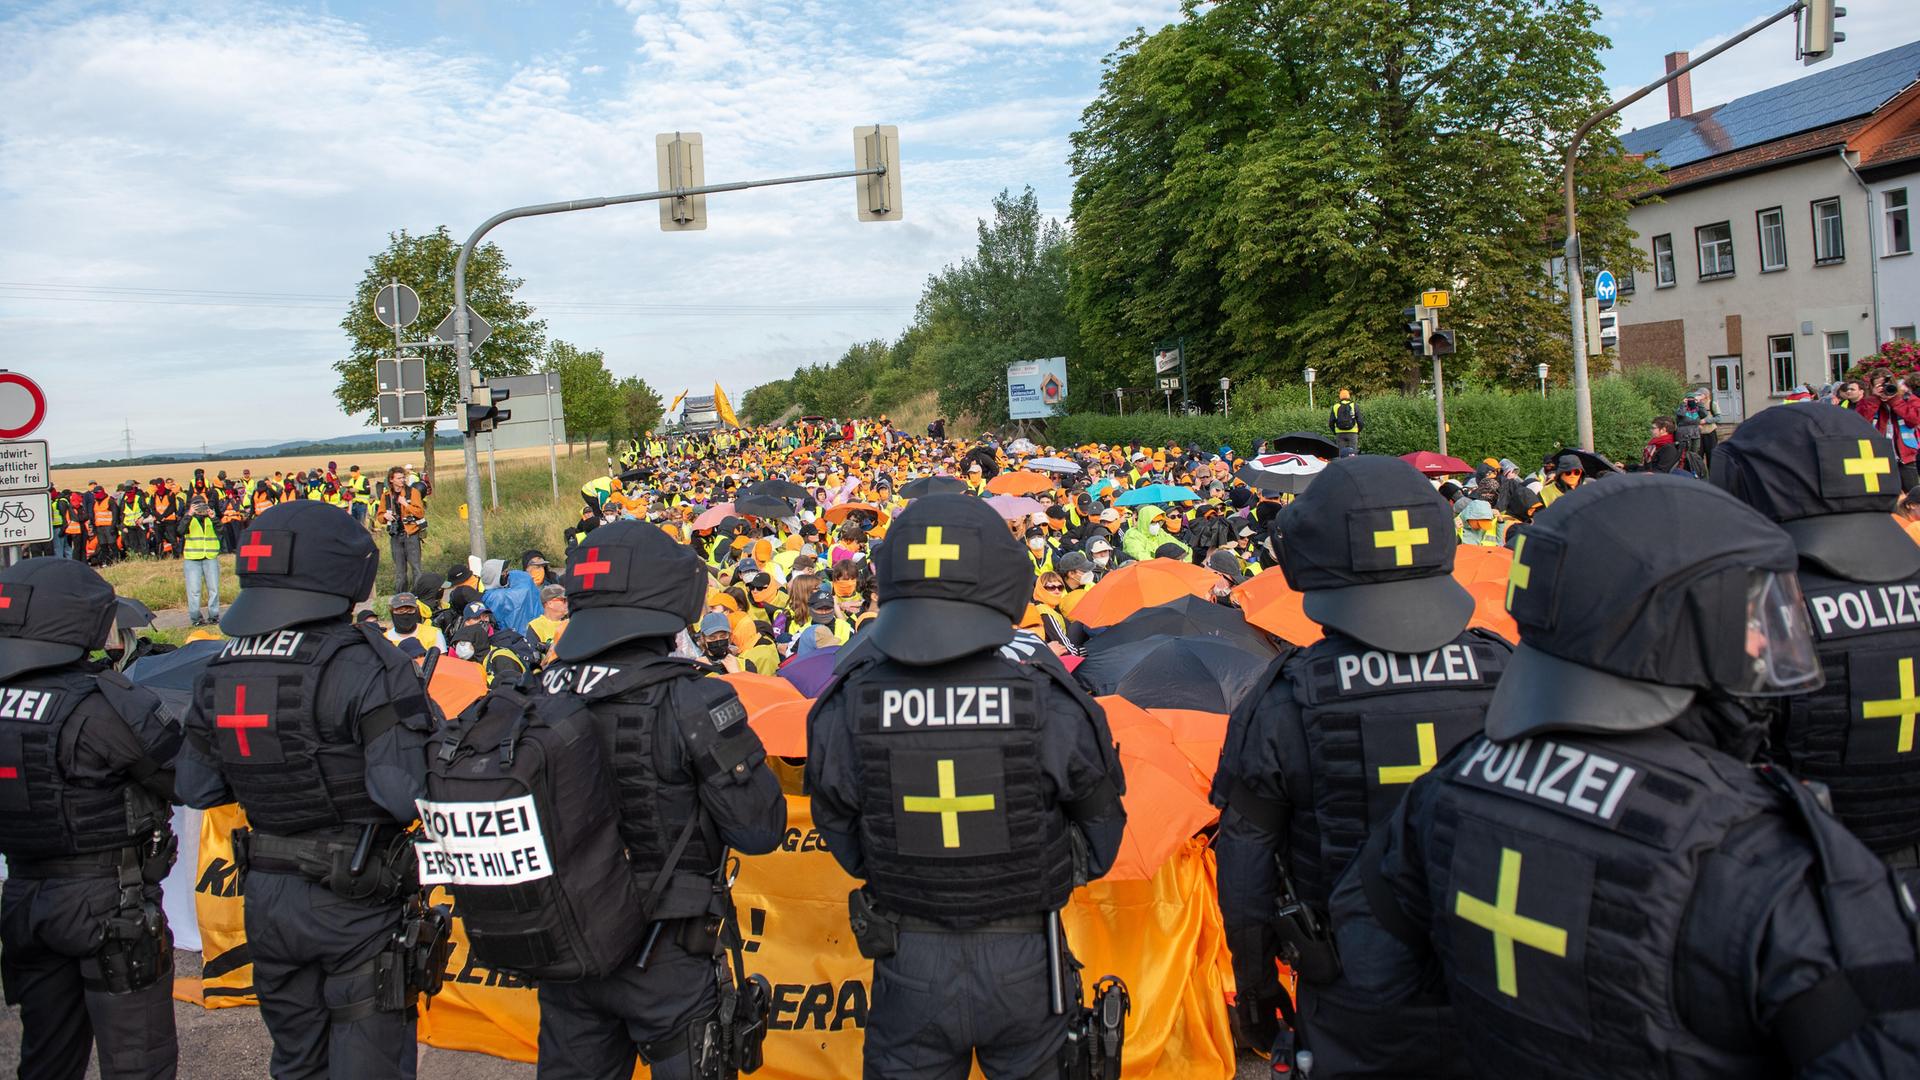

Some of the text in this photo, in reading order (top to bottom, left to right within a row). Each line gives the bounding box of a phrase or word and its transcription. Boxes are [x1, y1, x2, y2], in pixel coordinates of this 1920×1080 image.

[1432, 295, 1438, 304] 7
[24, 473, 40, 483] frei
[4, 526, 27, 538] frei
[220, 630, 304, 659] POLIZEI
[1338, 644, 1479, 691] POLIZEI
[882, 686, 1010, 728] POLIZEI
[1460, 738, 1637, 820] POLIZEI
[423, 805, 531, 838] POLIZEI
[422, 846, 541, 877] ERSTE HILFE
